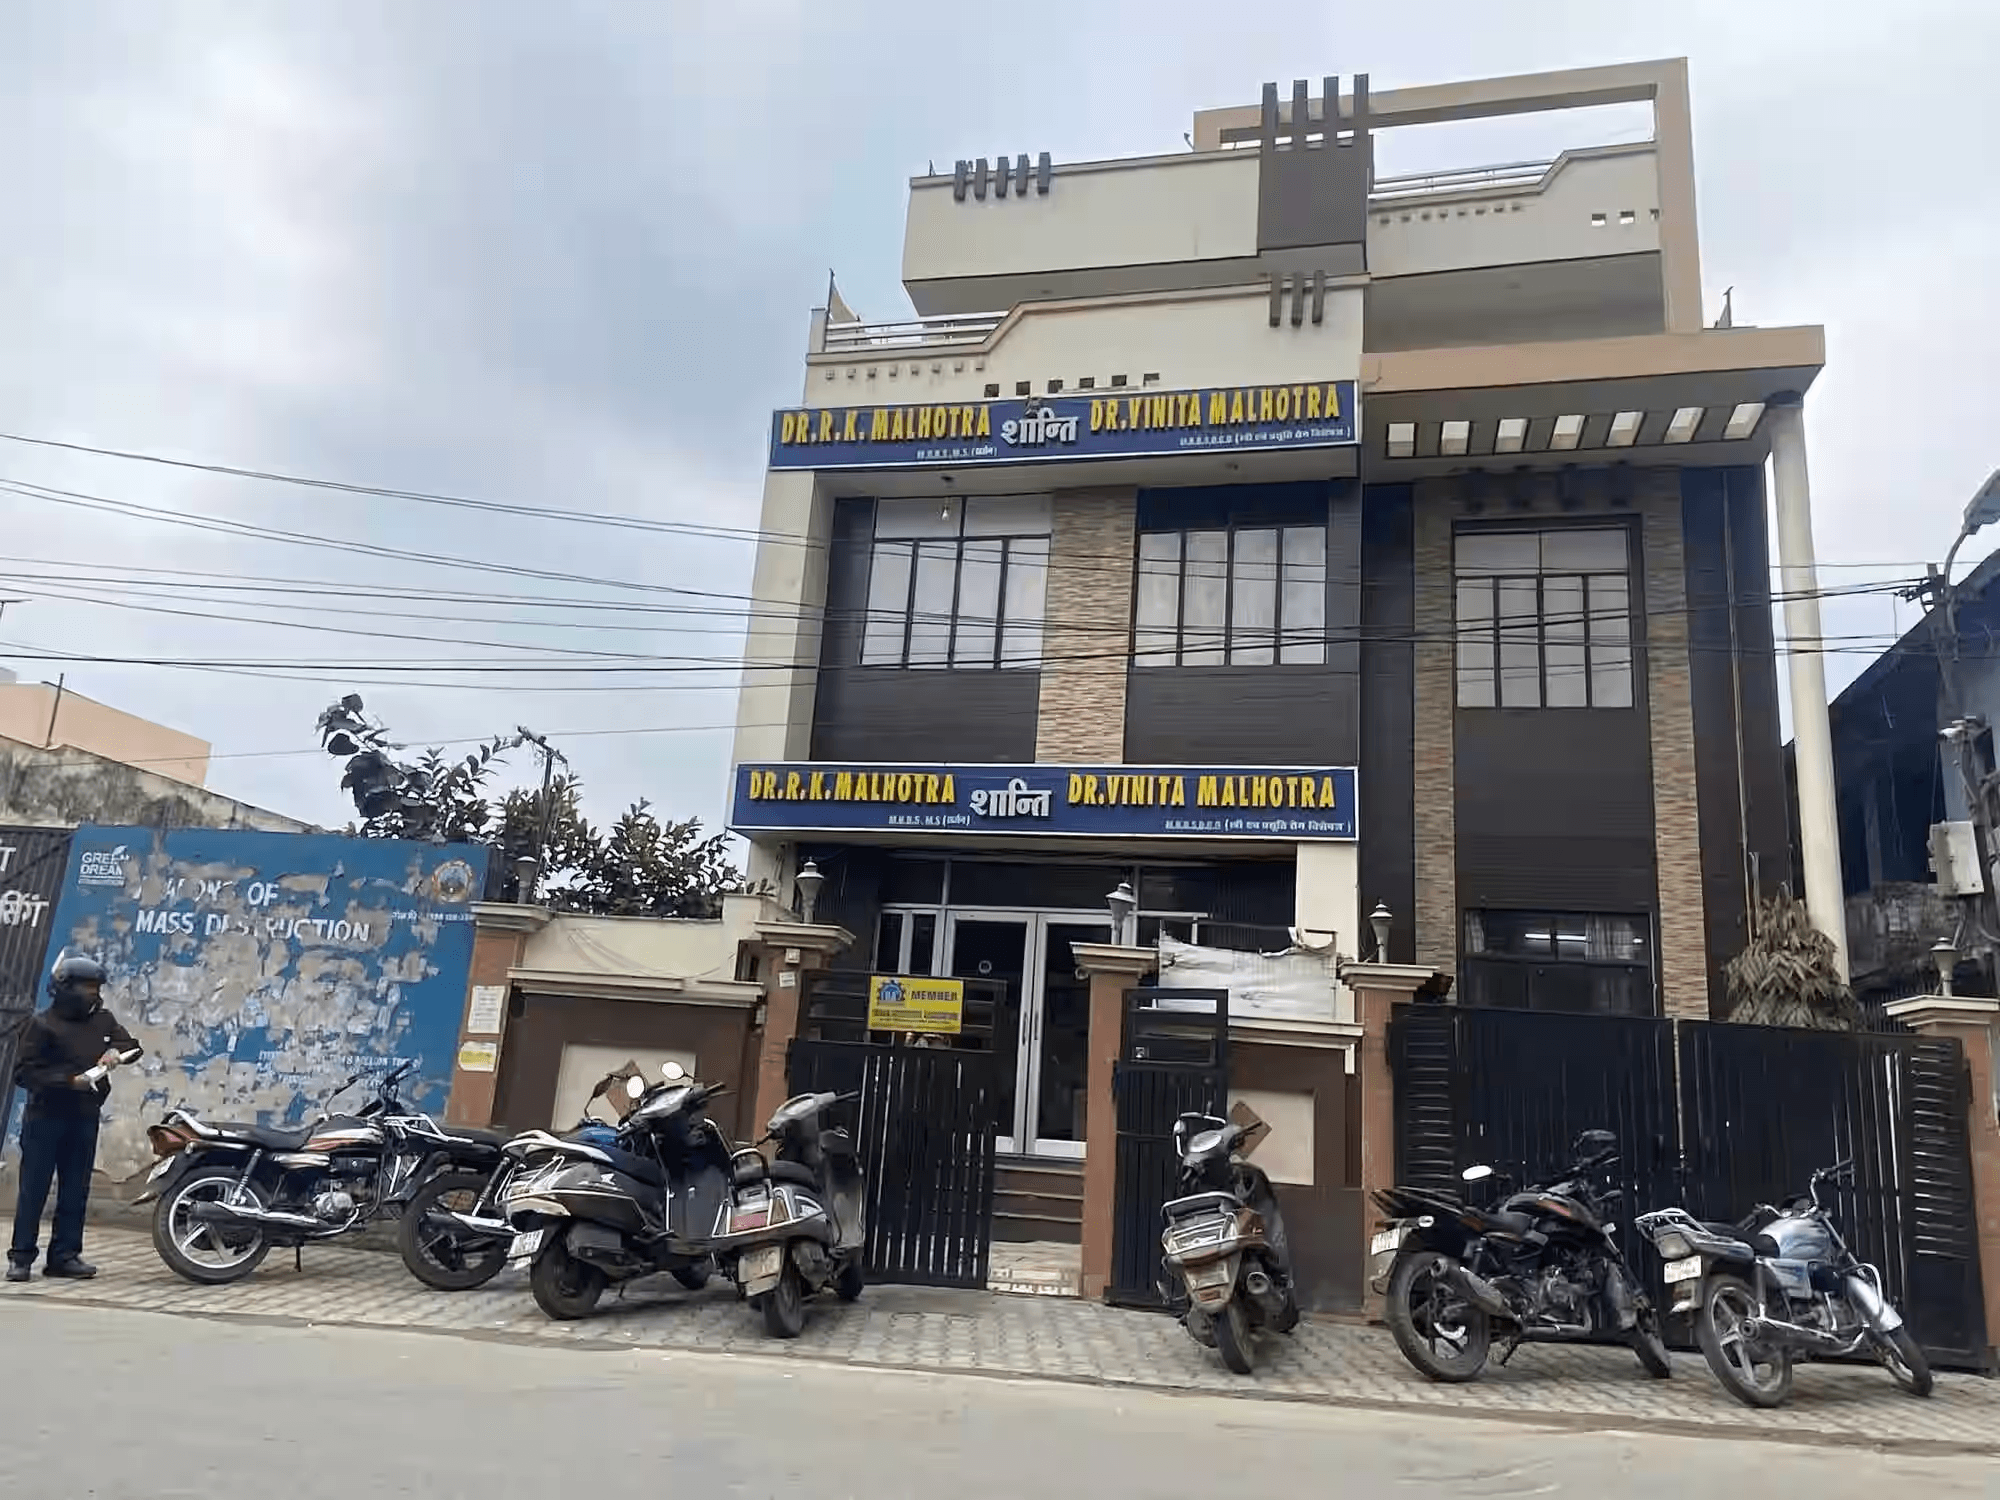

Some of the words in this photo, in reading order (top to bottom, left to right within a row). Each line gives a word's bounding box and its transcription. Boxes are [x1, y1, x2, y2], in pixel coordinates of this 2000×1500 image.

[871, 404, 991, 441] MALHOTRA
[1209, 384, 1340, 425] MALHOTRA
[1000, 407, 1079, 445] शान्ति
[969, 777, 1053, 817] शान्ति
[1197, 775, 1335, 808] MALHOTRA
[248, 881, 280, 906] OF
[135, 909, 194, 934] MASS
